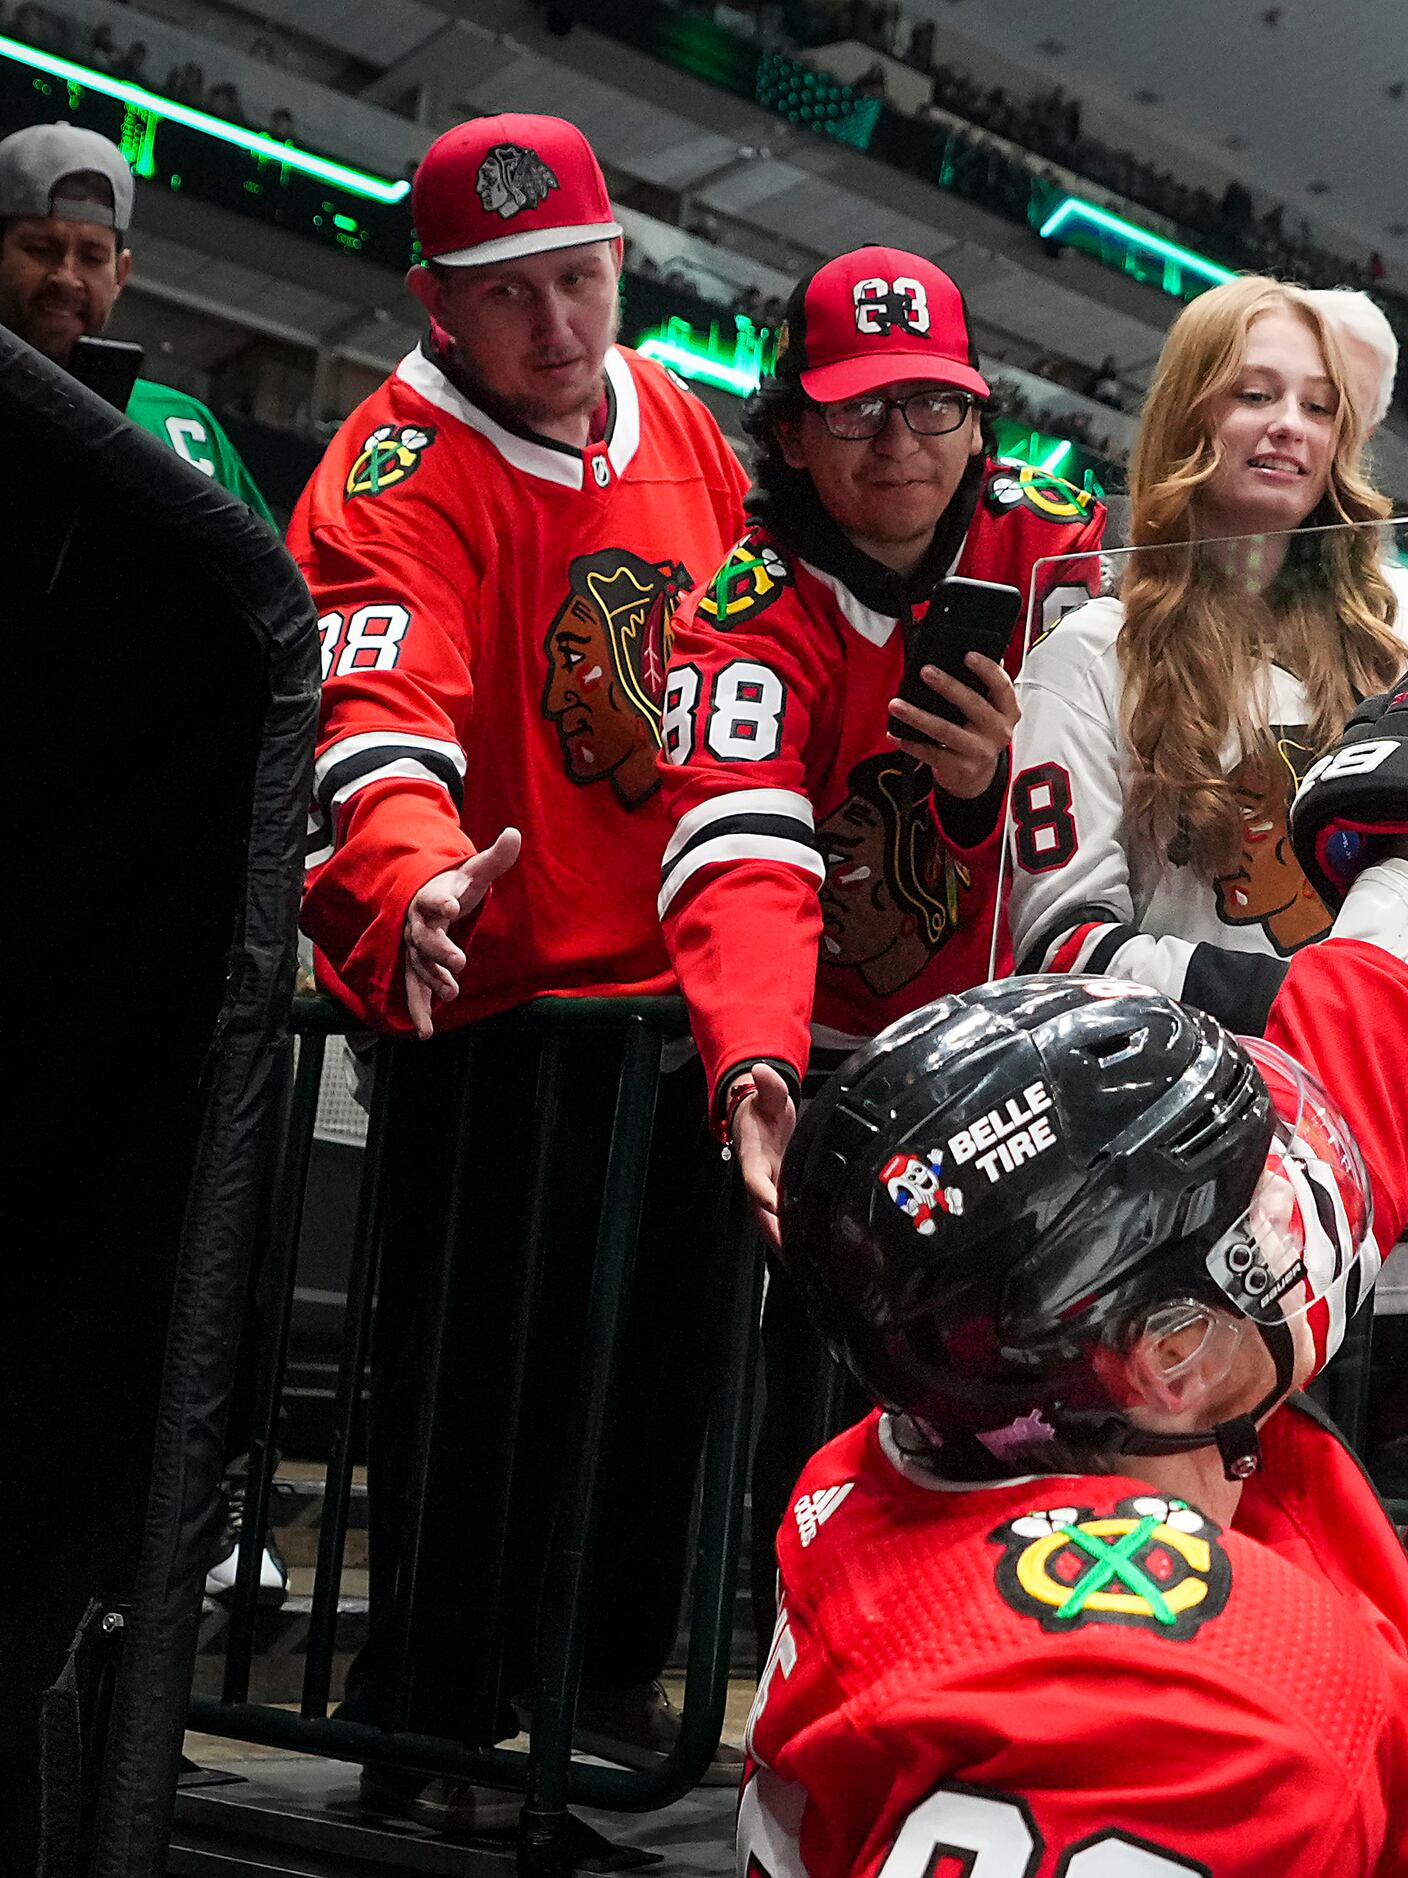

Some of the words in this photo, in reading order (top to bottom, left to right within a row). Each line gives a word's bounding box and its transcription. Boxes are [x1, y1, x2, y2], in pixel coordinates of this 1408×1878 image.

[660, 658, 788, 766] 88
[947, 1080, 1054, 1166] BELLE
[974, 1116, 1058, 1184] TIRE
